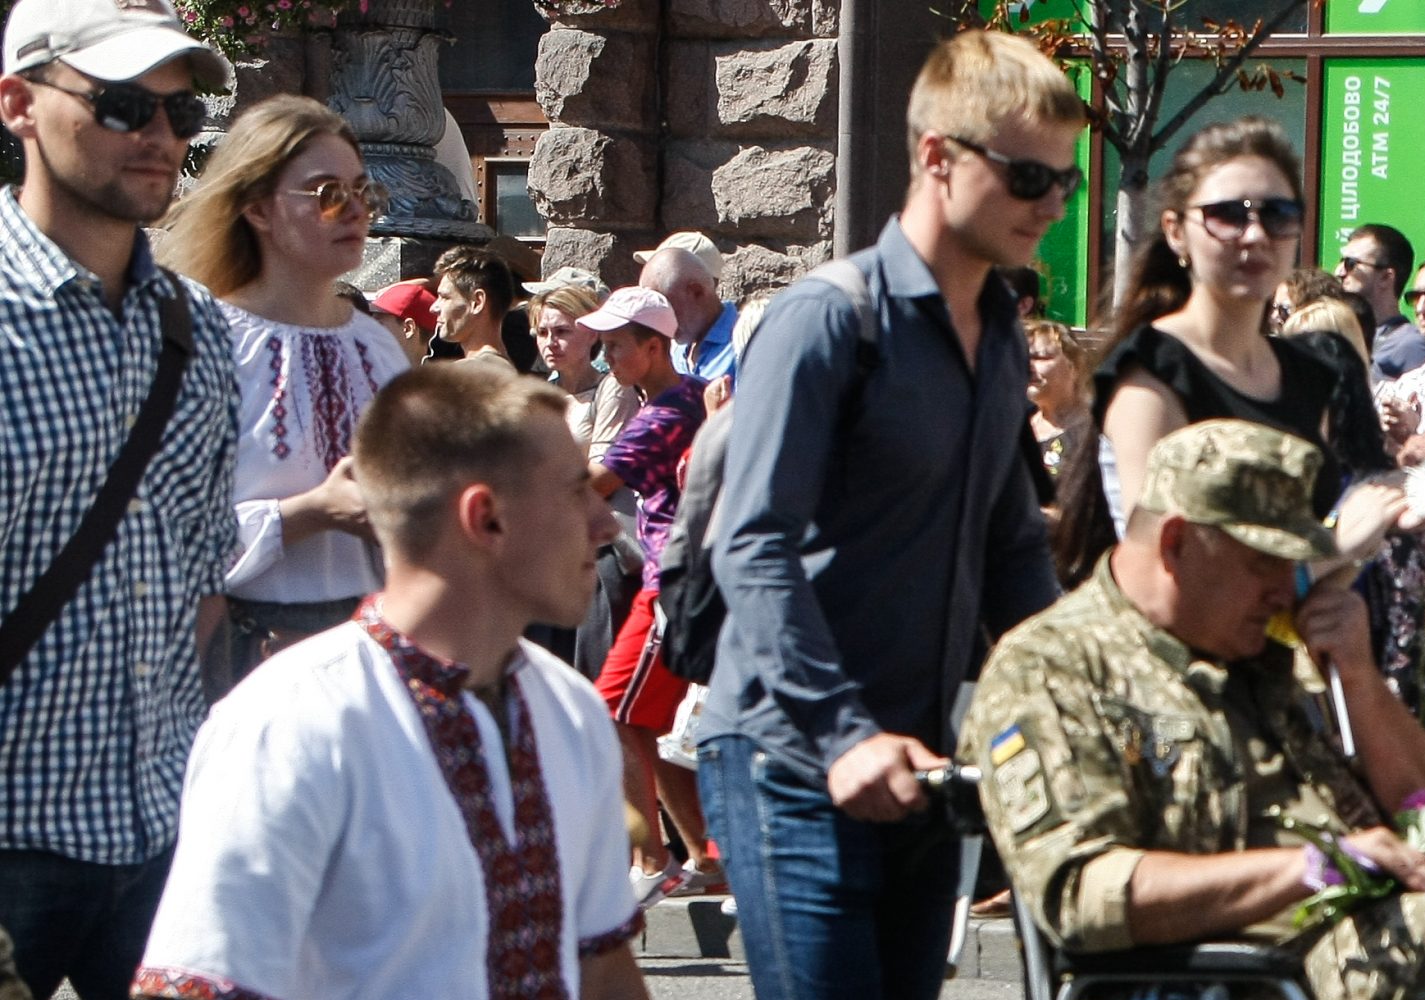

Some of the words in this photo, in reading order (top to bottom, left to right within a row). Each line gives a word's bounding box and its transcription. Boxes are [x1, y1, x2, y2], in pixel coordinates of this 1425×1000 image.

[1372, 75, 1391, 126] 24/7
[1340, 75, 1362, 220] ЦІЛОДОБОВО
[1371, 131, 1389, 179] ATM
